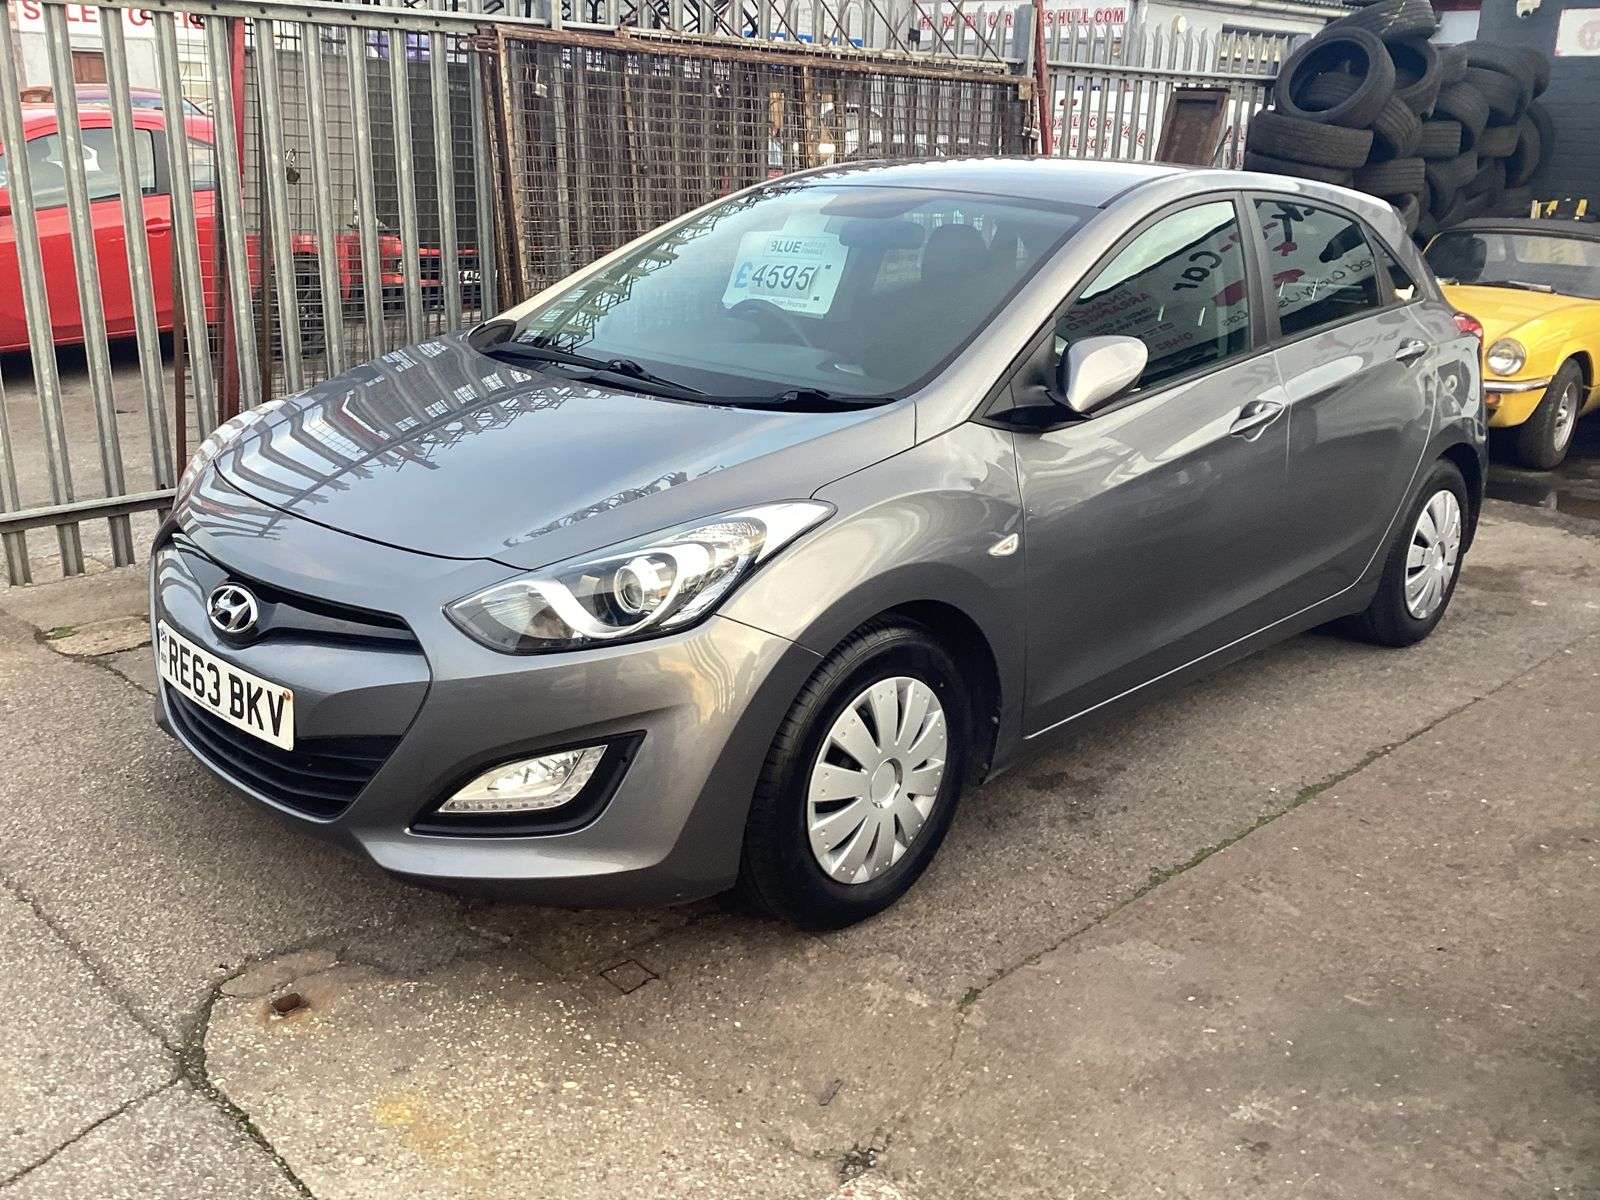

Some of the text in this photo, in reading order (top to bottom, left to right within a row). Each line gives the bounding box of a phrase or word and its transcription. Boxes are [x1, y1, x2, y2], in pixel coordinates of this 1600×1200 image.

[734, 261, 814, 292] £4595
[168, 635, 285, 738] RE63 BKV
